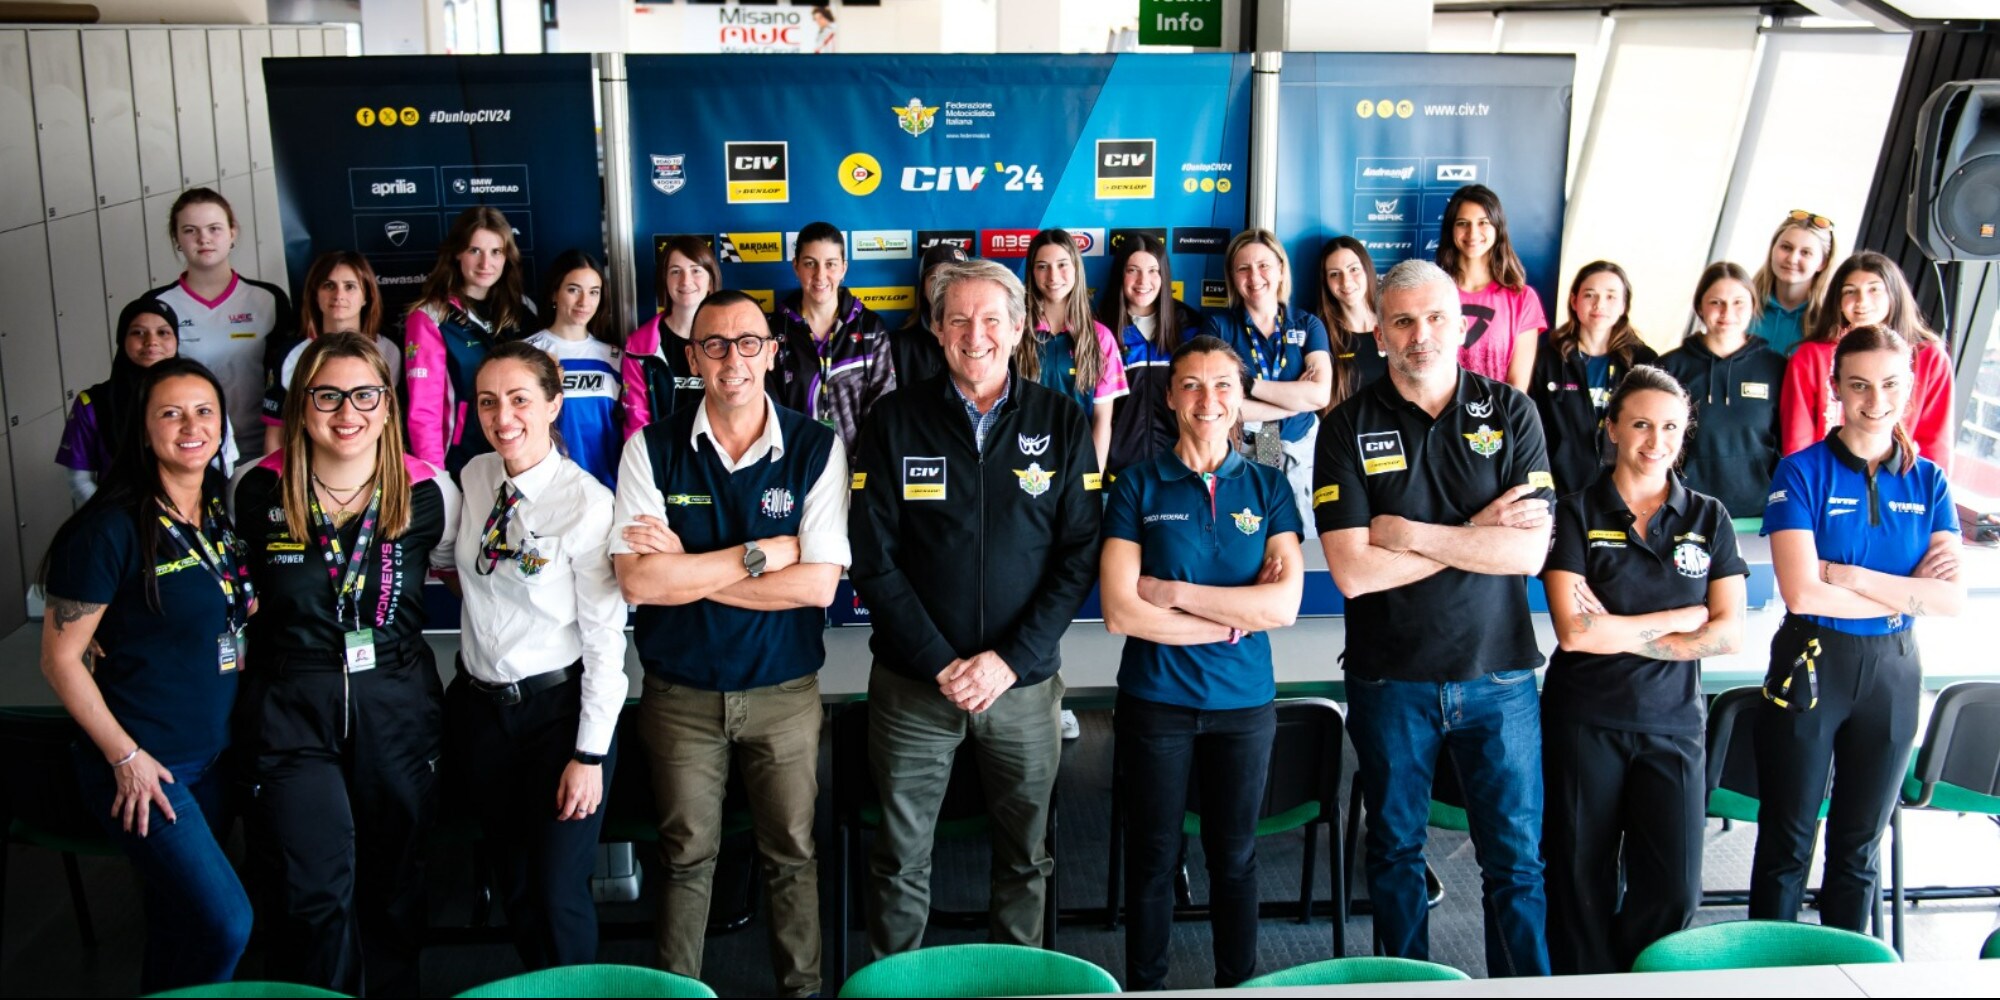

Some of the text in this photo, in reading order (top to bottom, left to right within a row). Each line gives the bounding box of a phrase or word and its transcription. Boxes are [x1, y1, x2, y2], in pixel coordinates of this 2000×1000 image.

[720, 8, 800, 25] Misano
[1156, 12, 1204, 31] Info
[1424, 103, 1489, 116] www.civ.tv
[429, 110, 511, 124] #DunlopCIV24
[734, 156, 779, 170] CIV
[1104, 153, 1146, 166] CIV
[901, 167, 988, 191] CIV
[371, 179, 416, 196] aprilia
[471, 185, 519, 193] MOTORRAD
[739, 242, 779, 252] BARDAHL
[1366, 441, 1394, 451] CIV
[910, 467, 939, 476] CIV
[394, 543, 403, 566] CUP
[375, 543, 393, 627] WOMEN'S
